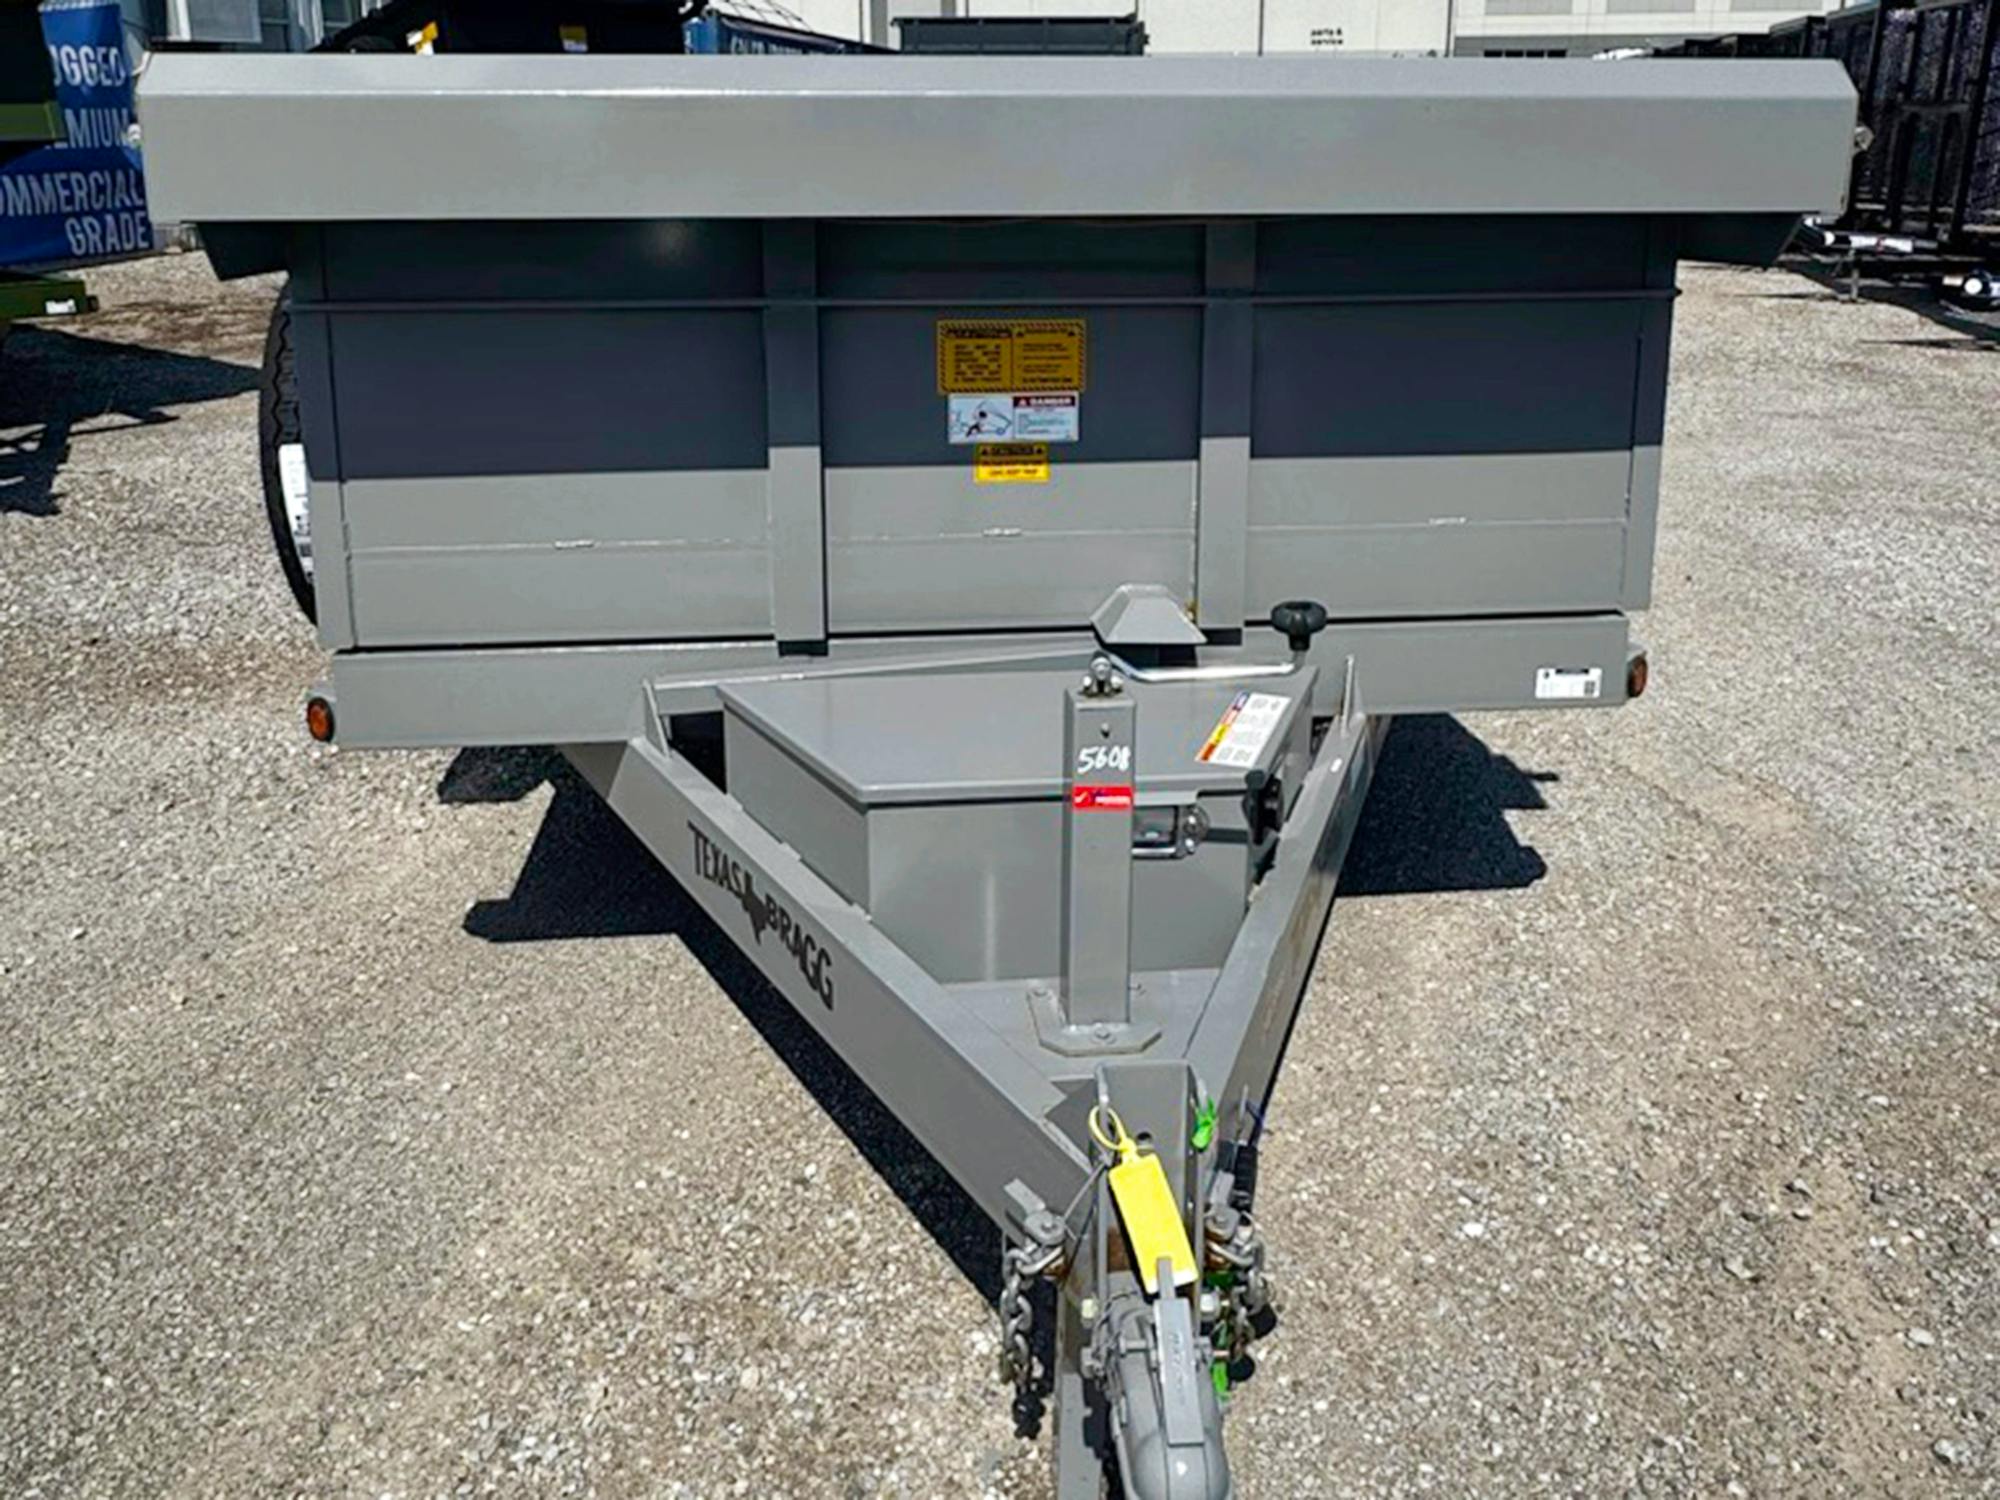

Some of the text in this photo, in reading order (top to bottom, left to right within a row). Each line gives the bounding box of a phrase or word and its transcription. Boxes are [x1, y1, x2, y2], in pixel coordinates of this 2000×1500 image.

[65, 211, 150, 256] GRADE
[1077, 745, 1131, 775] 5608
[687, 818, 834, 1012] TEXAS BRAGG
